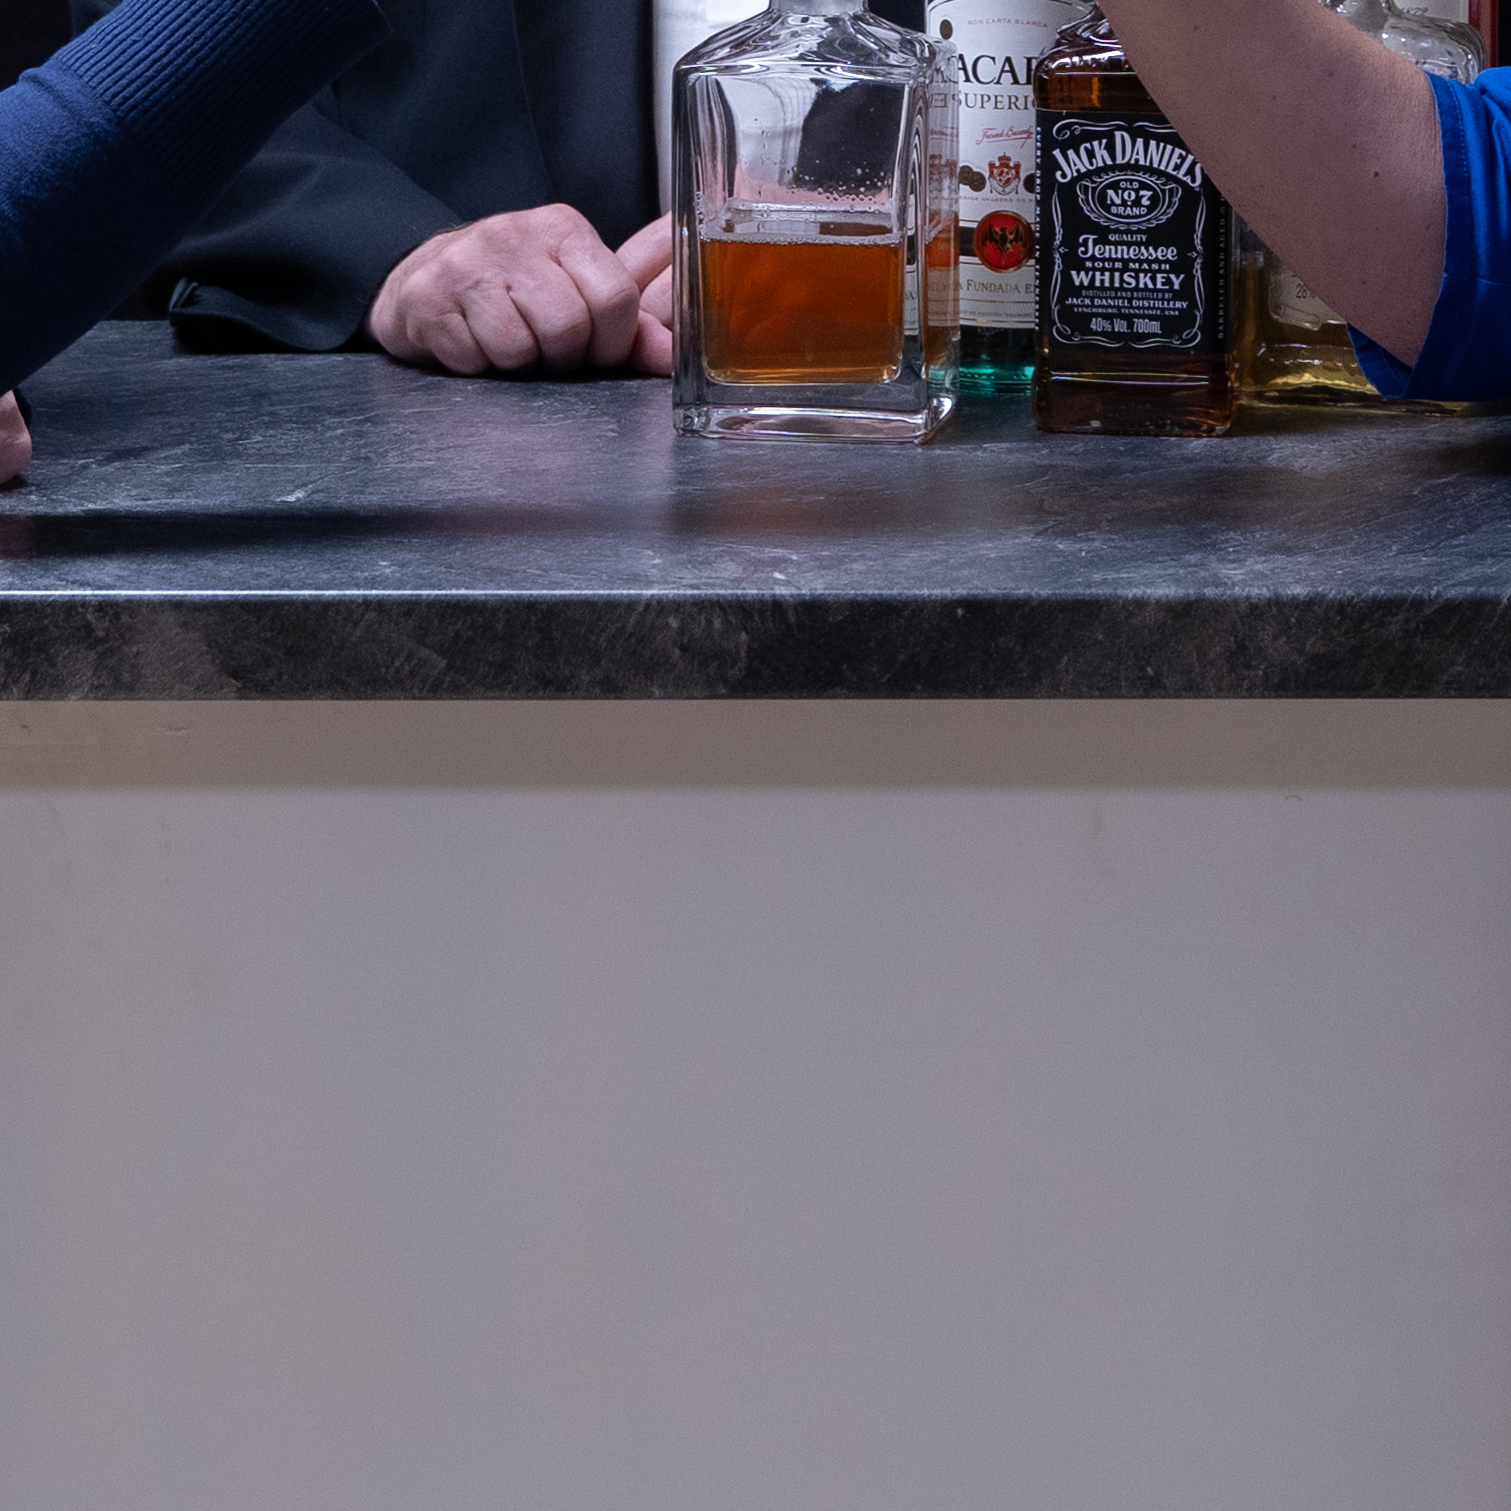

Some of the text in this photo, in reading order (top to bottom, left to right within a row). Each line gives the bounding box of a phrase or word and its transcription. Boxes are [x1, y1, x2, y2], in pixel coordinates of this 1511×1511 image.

[952, 91, 1036, 110] SUPERI
[1052, 139, 1113, 183] JACK
[1120, 181, 1139, 189] OLD
[1111, 206, 1148, 216] BRAND
[1109, 234, 1148, 242] QUALITY
[1078, 234, 1178, 260] Tennessee
[1129, 262, 1170, 270] MASH
[1070, 271, 1185, 290] WHISKEY
[1094, 298, 1130, 307] DANIEL
[1132, 300, 1188, 309] DISTILLERY
[1090, 317, 1112, 332] 40%
